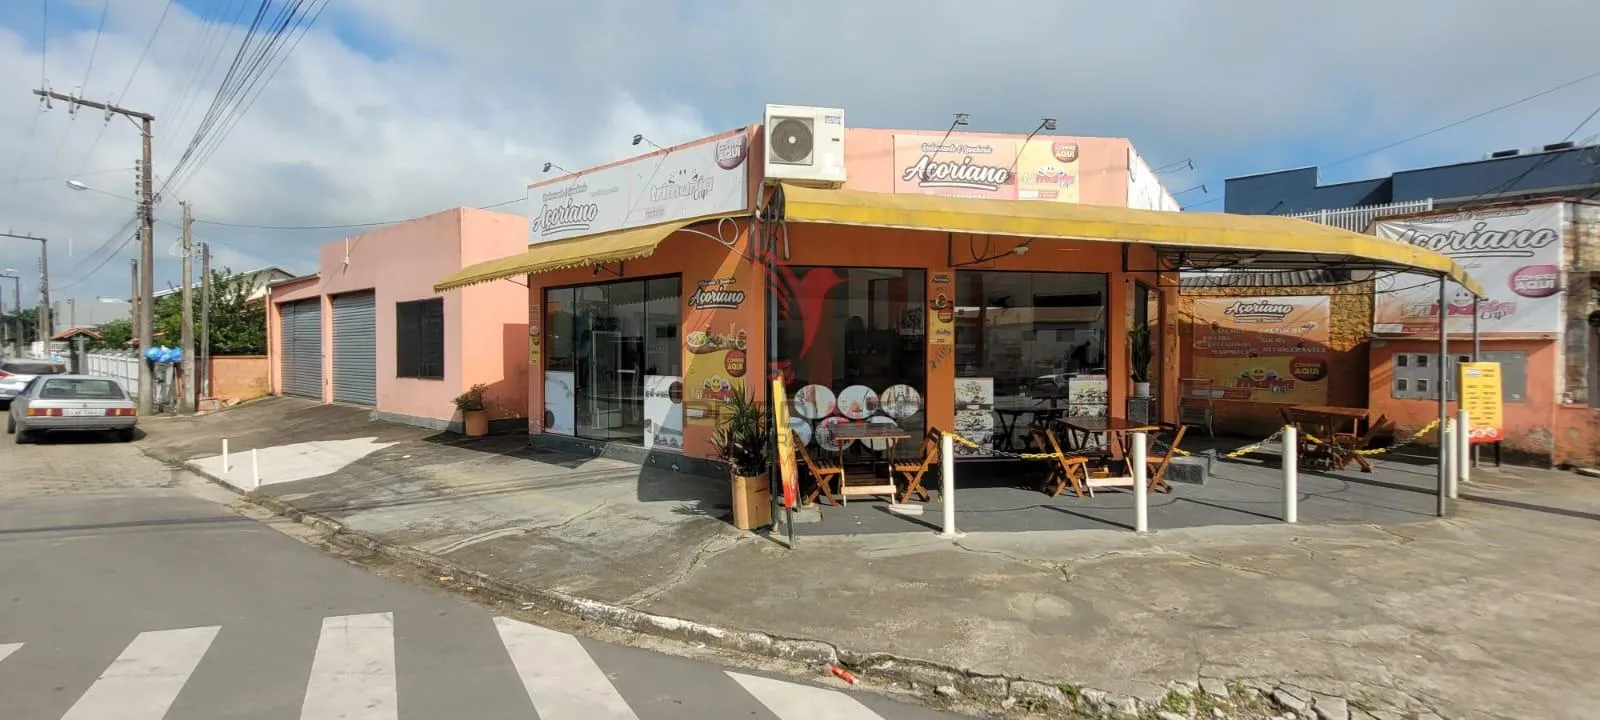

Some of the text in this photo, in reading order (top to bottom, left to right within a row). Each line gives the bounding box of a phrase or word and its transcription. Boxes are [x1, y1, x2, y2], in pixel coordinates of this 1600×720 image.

[719, 147, 742, 161] AQUI
[1055, 151, 1076, 159] AQUI
[903, 154, 1009, 184] Açoriano
[532, 198, 598, 232] Açoriano
[688, 285, 745, 305] Açoriano
[1224, 300, 1293, 314] Açoriano
